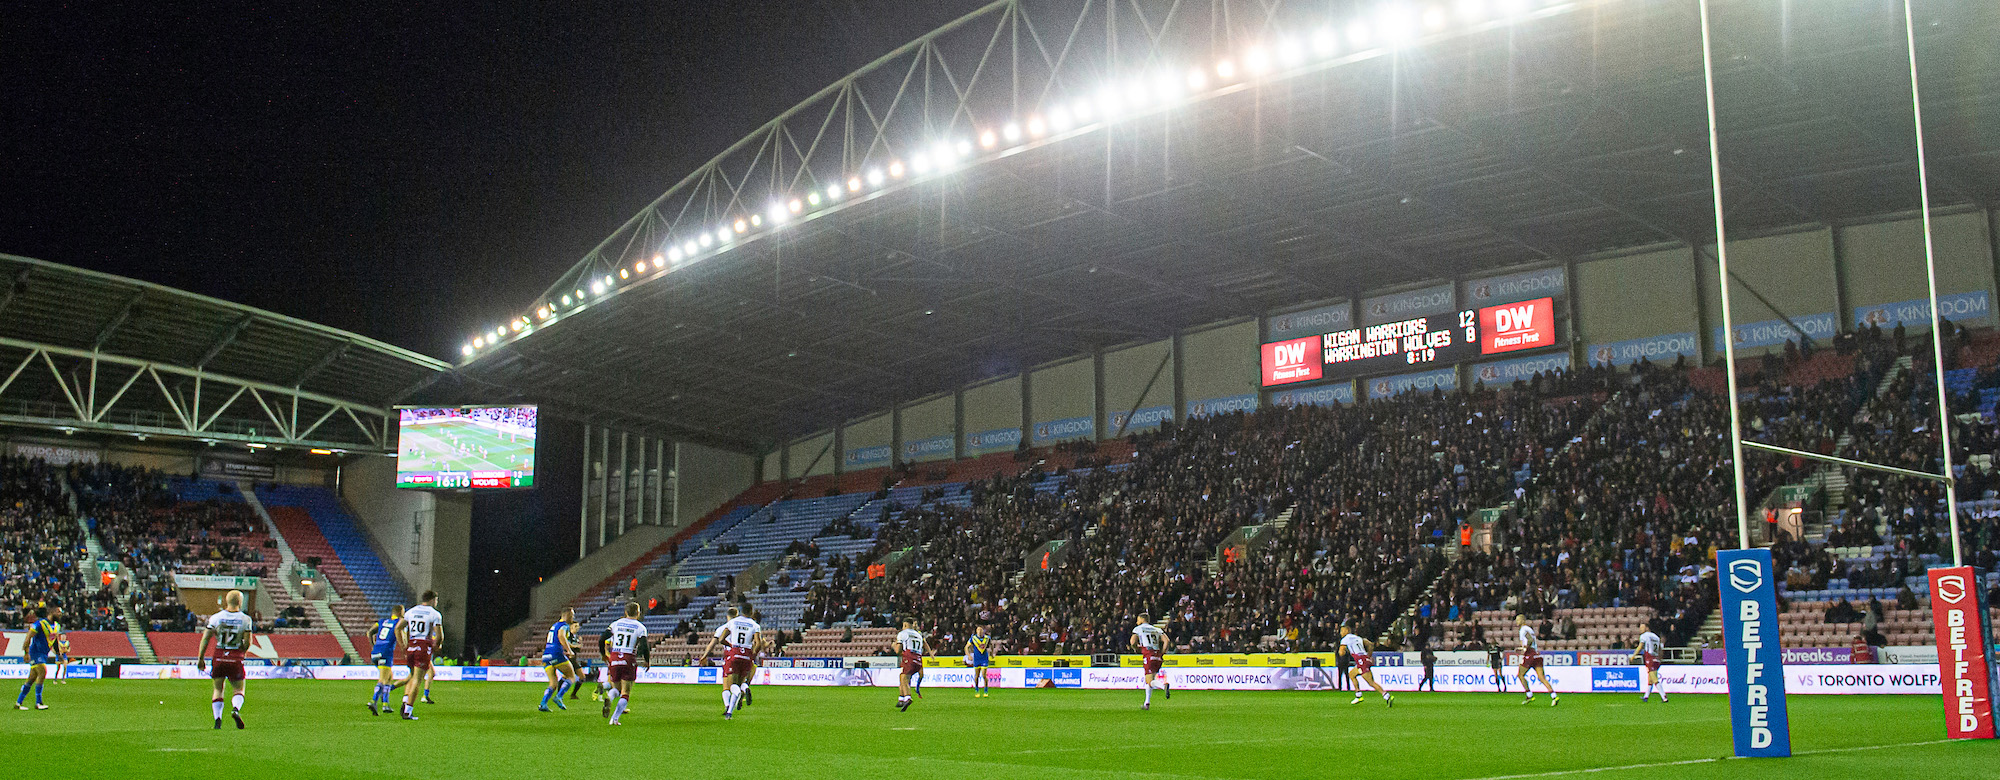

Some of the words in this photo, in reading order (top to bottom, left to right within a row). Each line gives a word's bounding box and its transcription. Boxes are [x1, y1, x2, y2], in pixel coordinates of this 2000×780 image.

[1459, 310, 1475, 328] 12
[1495, 304, 1535, 333] DW
[1324, 329, 1361, 349] WIGAN
[1366, 318, 1427, 342] WARRIORS
[1494, 335, 1521, 348] Fitness
[1522, 332, 1540, 344] First
[1325, 339, 1399, 365] WARRINGTON
[1403, 330, 1452, 353] WOLVES
[1622, 337, 1695, 359] KINGDOM
[1274, 342, 1306, 367] DW
[1406, 349, 1436, 365] 8:19
[436, 475, 470, 487] 16:16
[410, 620, 425, 633] 20
[615, 633, 631, 648] 31
[738, 632, 746, 645] 6
[762, 659, 792, 668] BETFRED
[795, 659, 826, 668] BETFRED
[827, 659, 842, 668] FIT
[1376, 656, 1401, 666] FIT
[1581, 654, 1629, 666] BETFR
[1740, 600, 1773, 749] BETFRED
[1947, 609, 1979, 732] BETFRED
[944, 674, 963, 682] FROM
[1185, 675, 1224, 684] TORONTO
[1226, 675, 1272, 684] WOLFPACK
[1380, 674, 1413, 685] TRAVEL
[1453, 674, 1485, 685] FROM
[1691, 676, 1727, 689] sponso
[1797, 675, 1814, 686] VS
[1818, 675, 1885, 686] TORONTO
[1889, 675, 1942, 686] WOLFP
